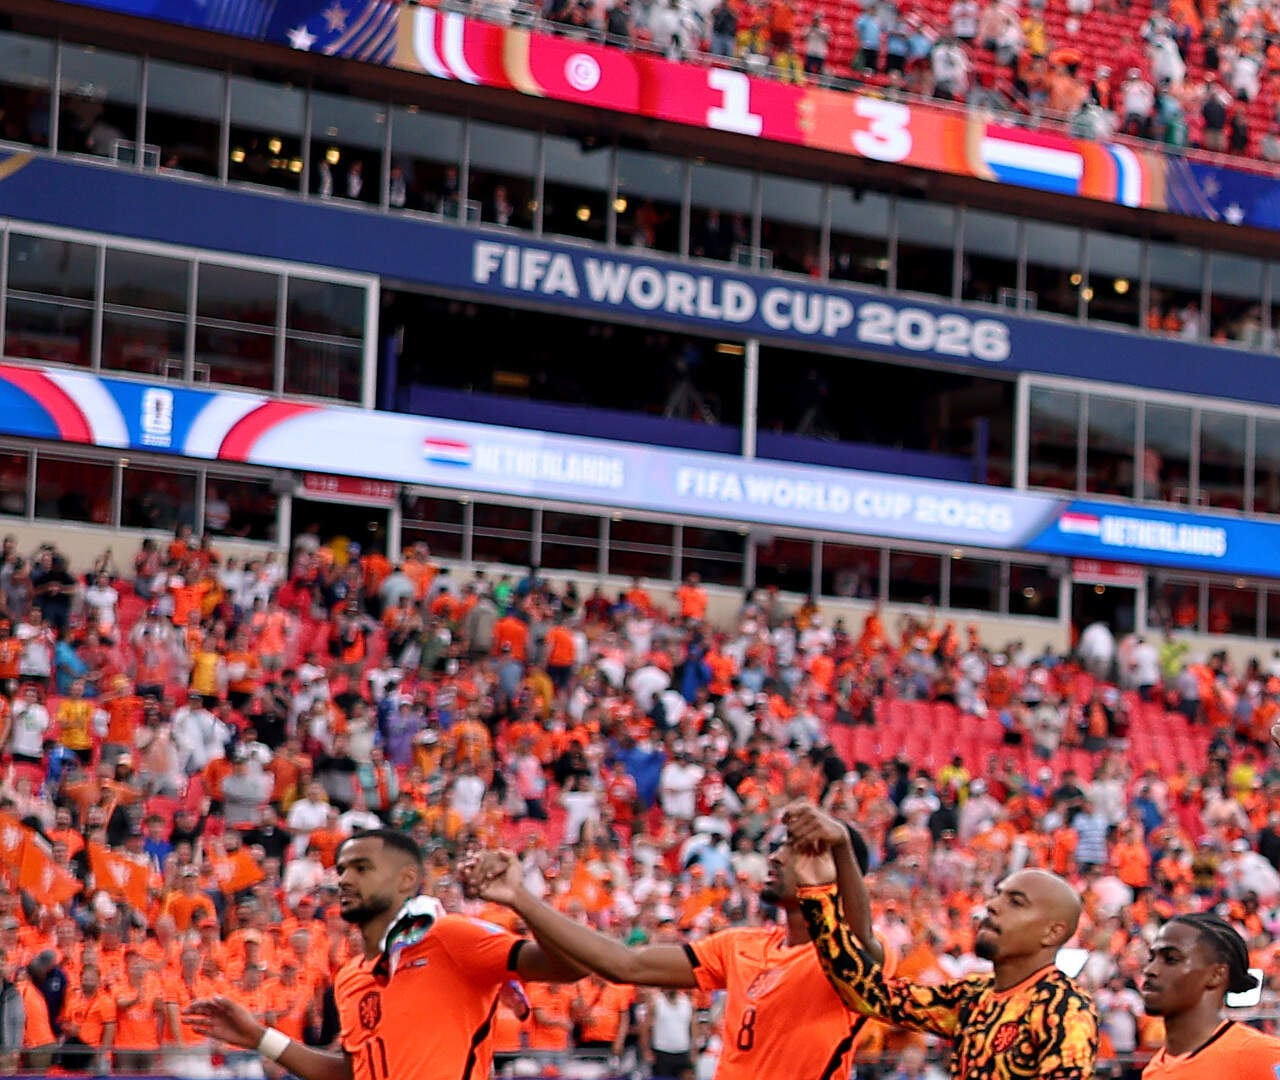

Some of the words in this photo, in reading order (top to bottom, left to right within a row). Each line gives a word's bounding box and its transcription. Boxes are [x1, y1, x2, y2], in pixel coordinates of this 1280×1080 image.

[706, 69, 762, 136] 1
[851, 98, 912, 162] 3
[472, 240, 580, 298] FIFA
[584, 258, 757, 324] WORLD
[762, 286, 854, 337] CUP
[857, 301, 1010, 363] 2026
[678, 467, 744, 500] FIFA
[745, 475, 850, 514] WORLD
[854, 494, 912, 520] CUP
[914, 497, 1013, 532] 2026
[736, 1008, 756, 1052] 8
